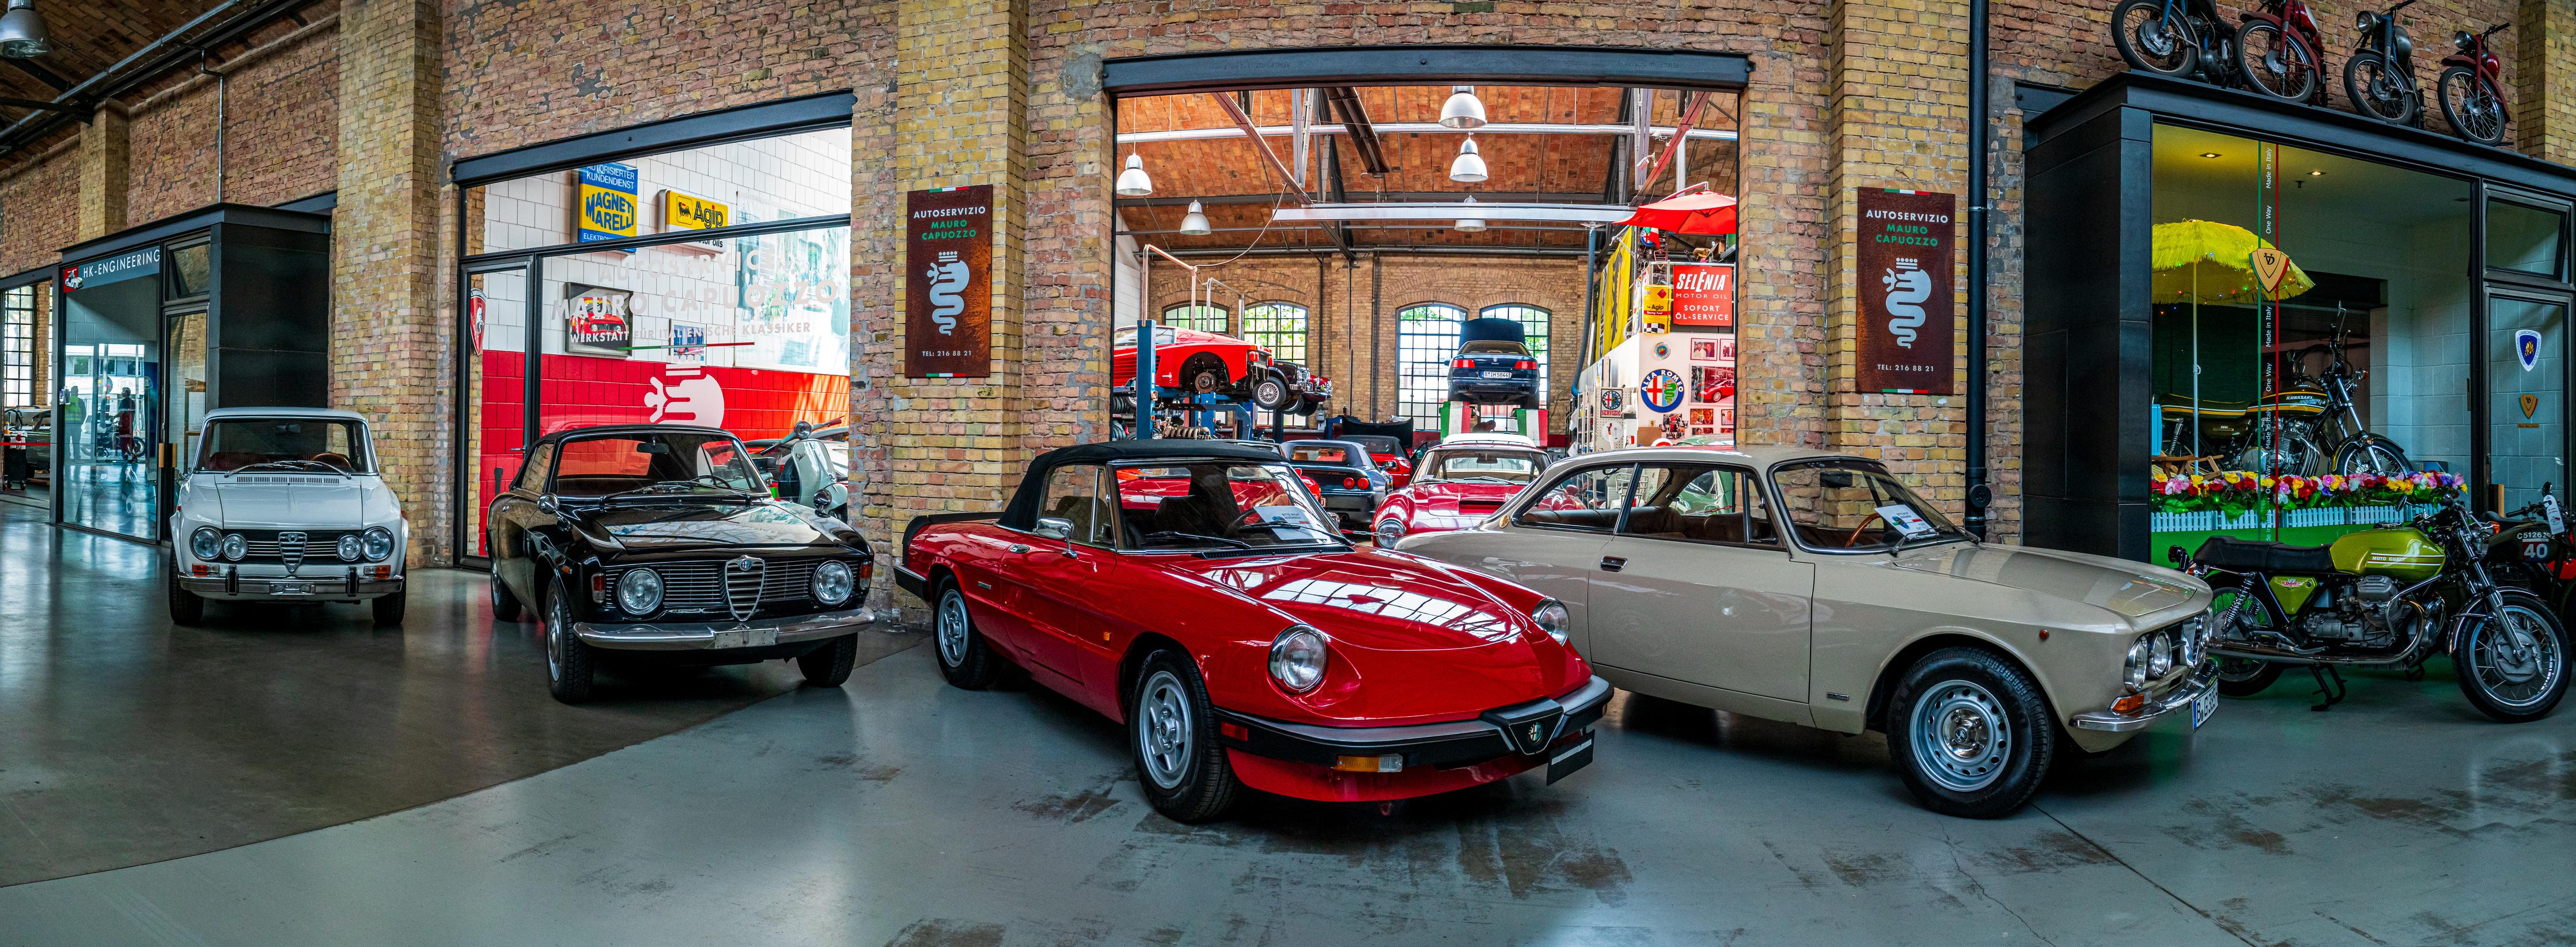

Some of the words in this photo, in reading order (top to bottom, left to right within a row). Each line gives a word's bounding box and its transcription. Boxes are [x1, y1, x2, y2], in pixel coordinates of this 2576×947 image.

[586, 171, 634, 189] KUNDENDIENST
[586, 191, 634, 221] MAGNETI
[693, 200, 723, 229] Agip
[913, 206, 986, 218] AUTOSERVIZIO
[586, 202, 634, 231] MARELLI
[931, 219, 967, 229] MAURO
[1866, 210, 1948, 224] AUTOSERVIZIO
[922, 229, 976, 240] CAPUOZZO
[1886, 224, 1928, 234] MAURO
[712, 238, 723, 248] oils
[1876, 234, 1938, 247] CAPUOZZO
[83, 249, 160, 278] HK-ENGINEERING
[600, 248, 775, 283] AUTOSERVICE
[551, 293, 647, 320] MAURO
[663, 279, 838, 312] CAPUOZZO
[1675, 312, 1729, 320] ÖL-SERVICE
[570, 331, 630, 343] WERKSTATT
[634, 328, 654, 339] FÜR
[660, 325, 736, 339] ITALIENISCHE
[743, 322, 810, 335] KLASSIKER
[1642, 372, 1657, 392] ALFA
[1661, 369, 1684, 392] ROMEO
[2524, 543, 2548, 559] 40
[2197, 702, 2201, 723] B
